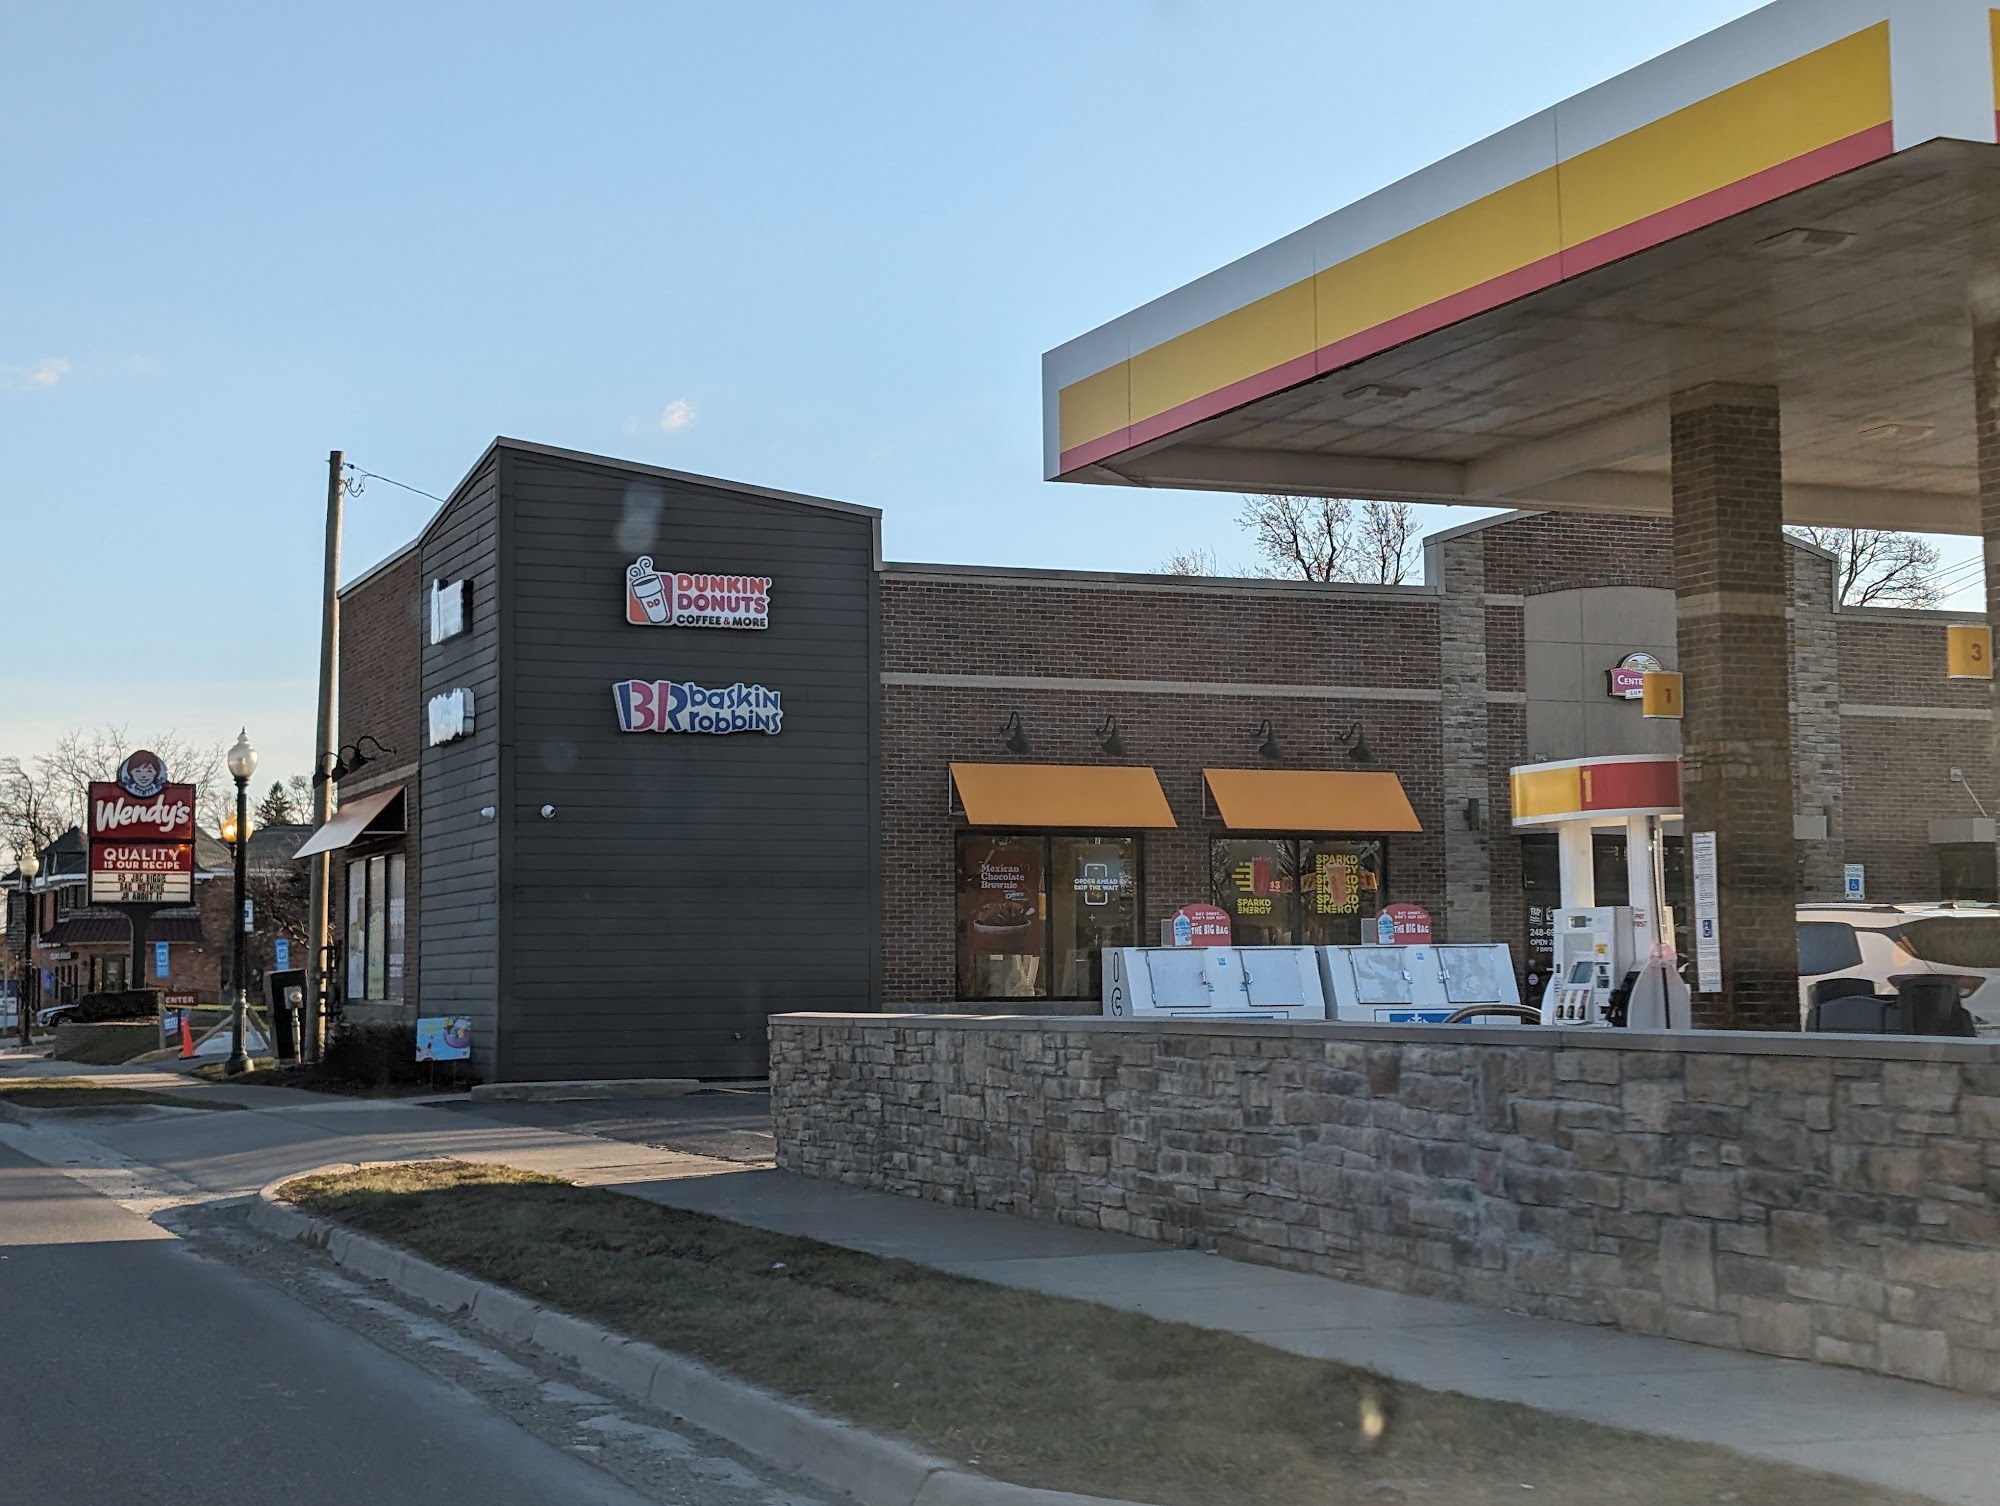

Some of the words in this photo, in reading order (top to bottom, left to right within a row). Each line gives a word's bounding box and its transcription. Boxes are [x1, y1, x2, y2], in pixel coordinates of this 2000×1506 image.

[678, 574, 770, 595] DUNKIN'
[646, 598, 661, 609] DD
[678, 594, 766, 614] DONUTS
[677, 615, 721, 625] COFFEE
[723, 617, 730, 625] &
[732, 617, 766, 627] MORE
[1971, 643, 1982, 661] 3
[688, 683, 779, 710] baskin
[1665, 688, 1672, 703] 1
[689, 710, 780, 733] robbins
[1582, 770, 1593, 803] 1
[96, 794, 191, 832] Wendy's
[104, 848, 179, 862] QUALITY
[1315, 854, 1358, 865] SPARKD
[143, 861, 180, 870] RECIPE
[981, 864, 1019, 873] Mexican
[981, 872, 1025, 881] Chocolate
[1270, 881, 1280, 889] $3
[1236, 898, 1271, 907] SPARKD
[1317, 904, 1360, 914] ENERGY
[1191, 926, 1202, 935] THE
[1203, 924, 1215, 935] BIG
[1215, 924, 1229, 935] BAG
[1394, 925, 1404, 933] THE
[1405, 923, 1416, 934] BIG
[1416, 924, 1429, 934] BAG
[165, 996, 194, 1004] ENTER
